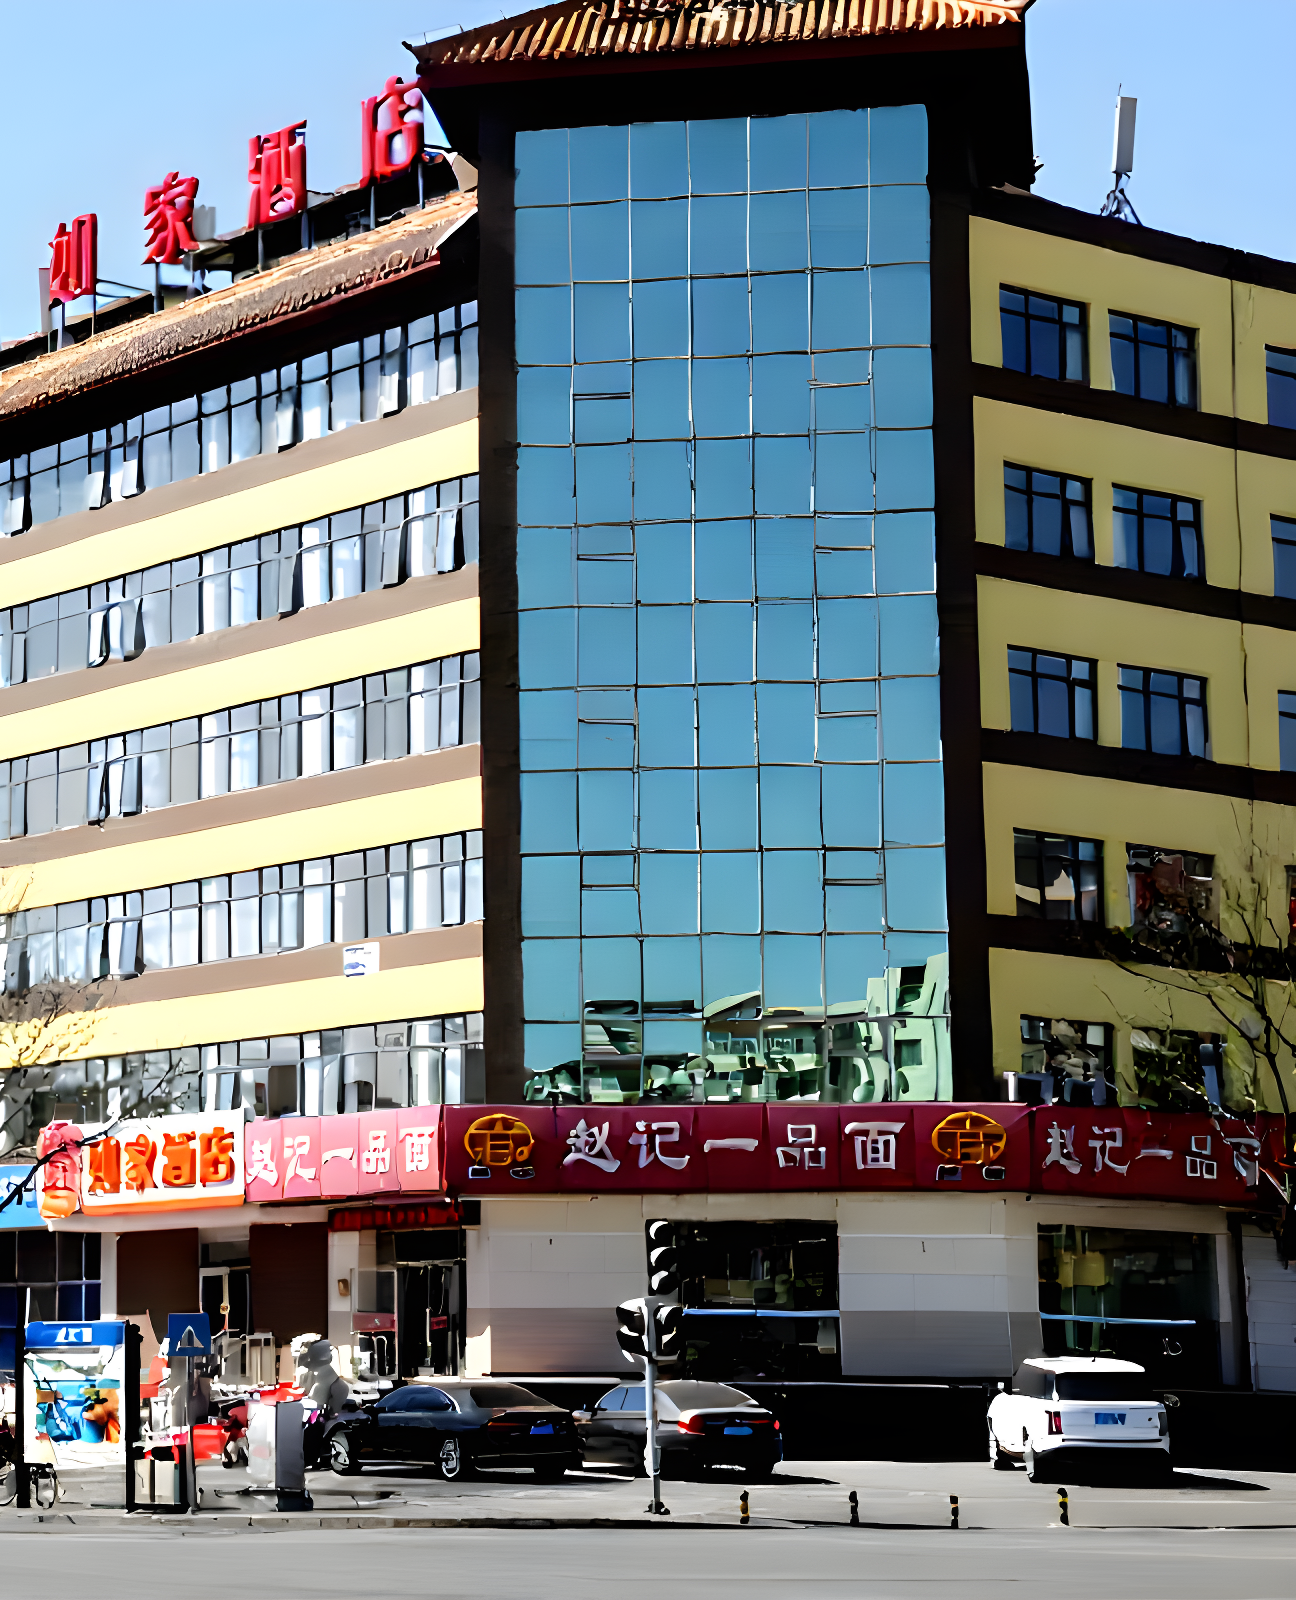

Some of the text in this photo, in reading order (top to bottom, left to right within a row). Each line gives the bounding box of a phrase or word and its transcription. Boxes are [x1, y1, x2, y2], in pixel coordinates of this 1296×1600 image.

[246, 1126, 436, 1186] 赵记一品面
[562, 1118, 906, 1173] 赵记一品面
